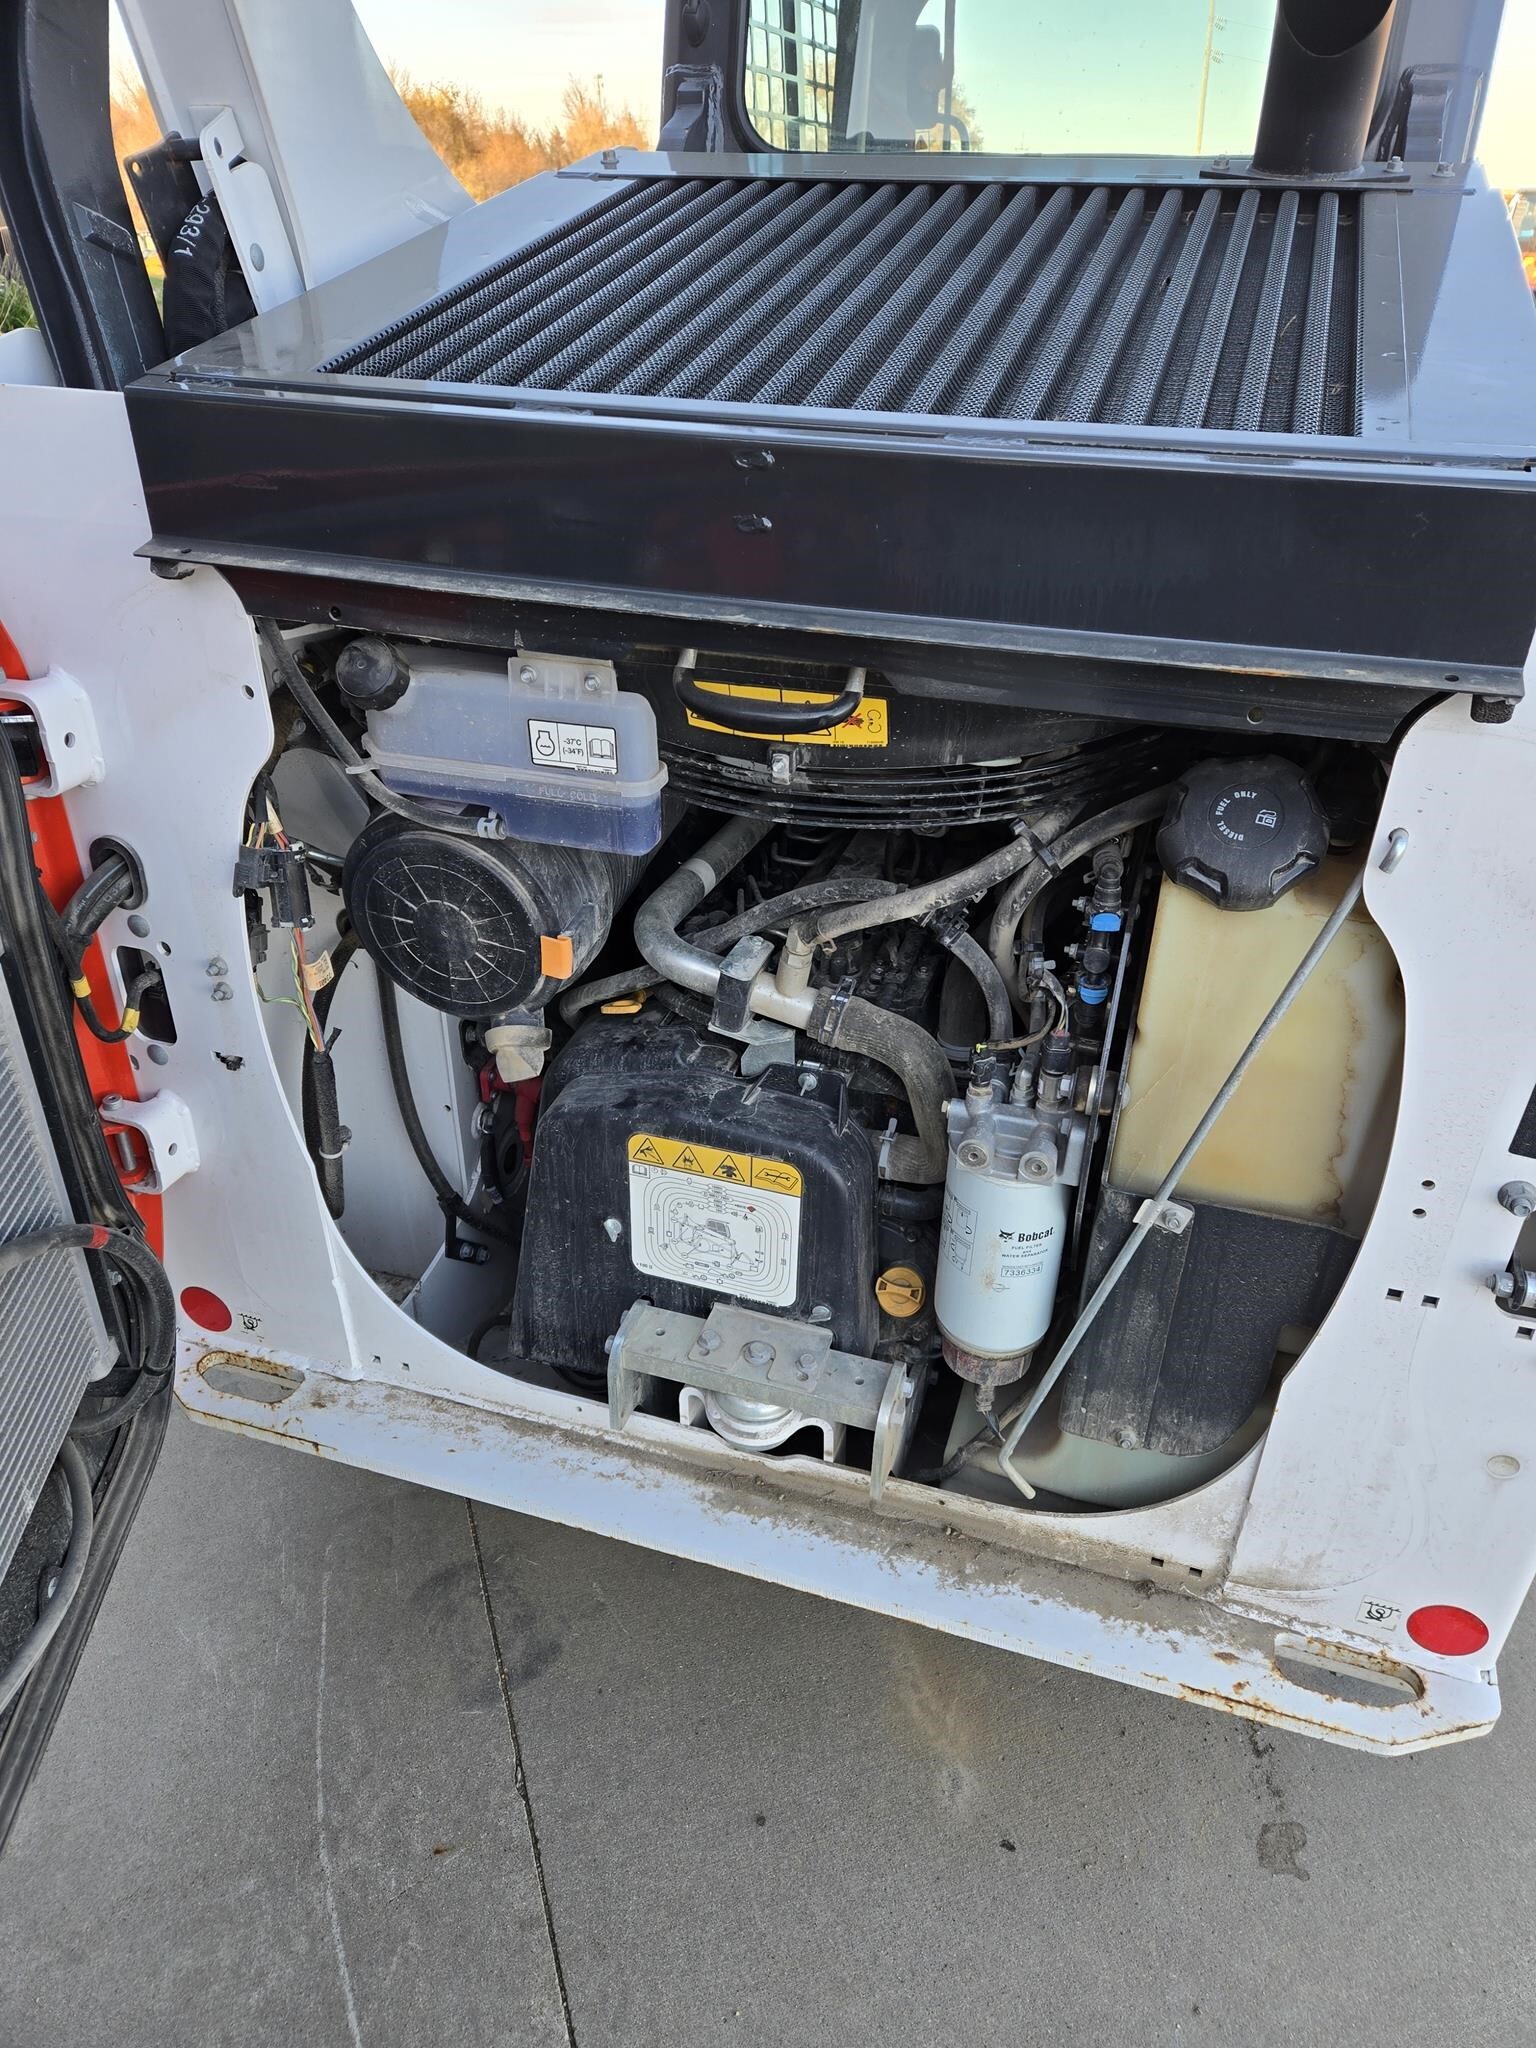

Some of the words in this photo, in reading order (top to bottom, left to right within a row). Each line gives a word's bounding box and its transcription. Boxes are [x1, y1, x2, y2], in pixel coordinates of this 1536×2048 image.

[1234, 790, 1257, 799] ONLY
[1215, 798, 1231, 816] FUEL
[1217, 820, 1243, 841] DIESEL
[1018, 1226, 1053, 1242] Bobcat
